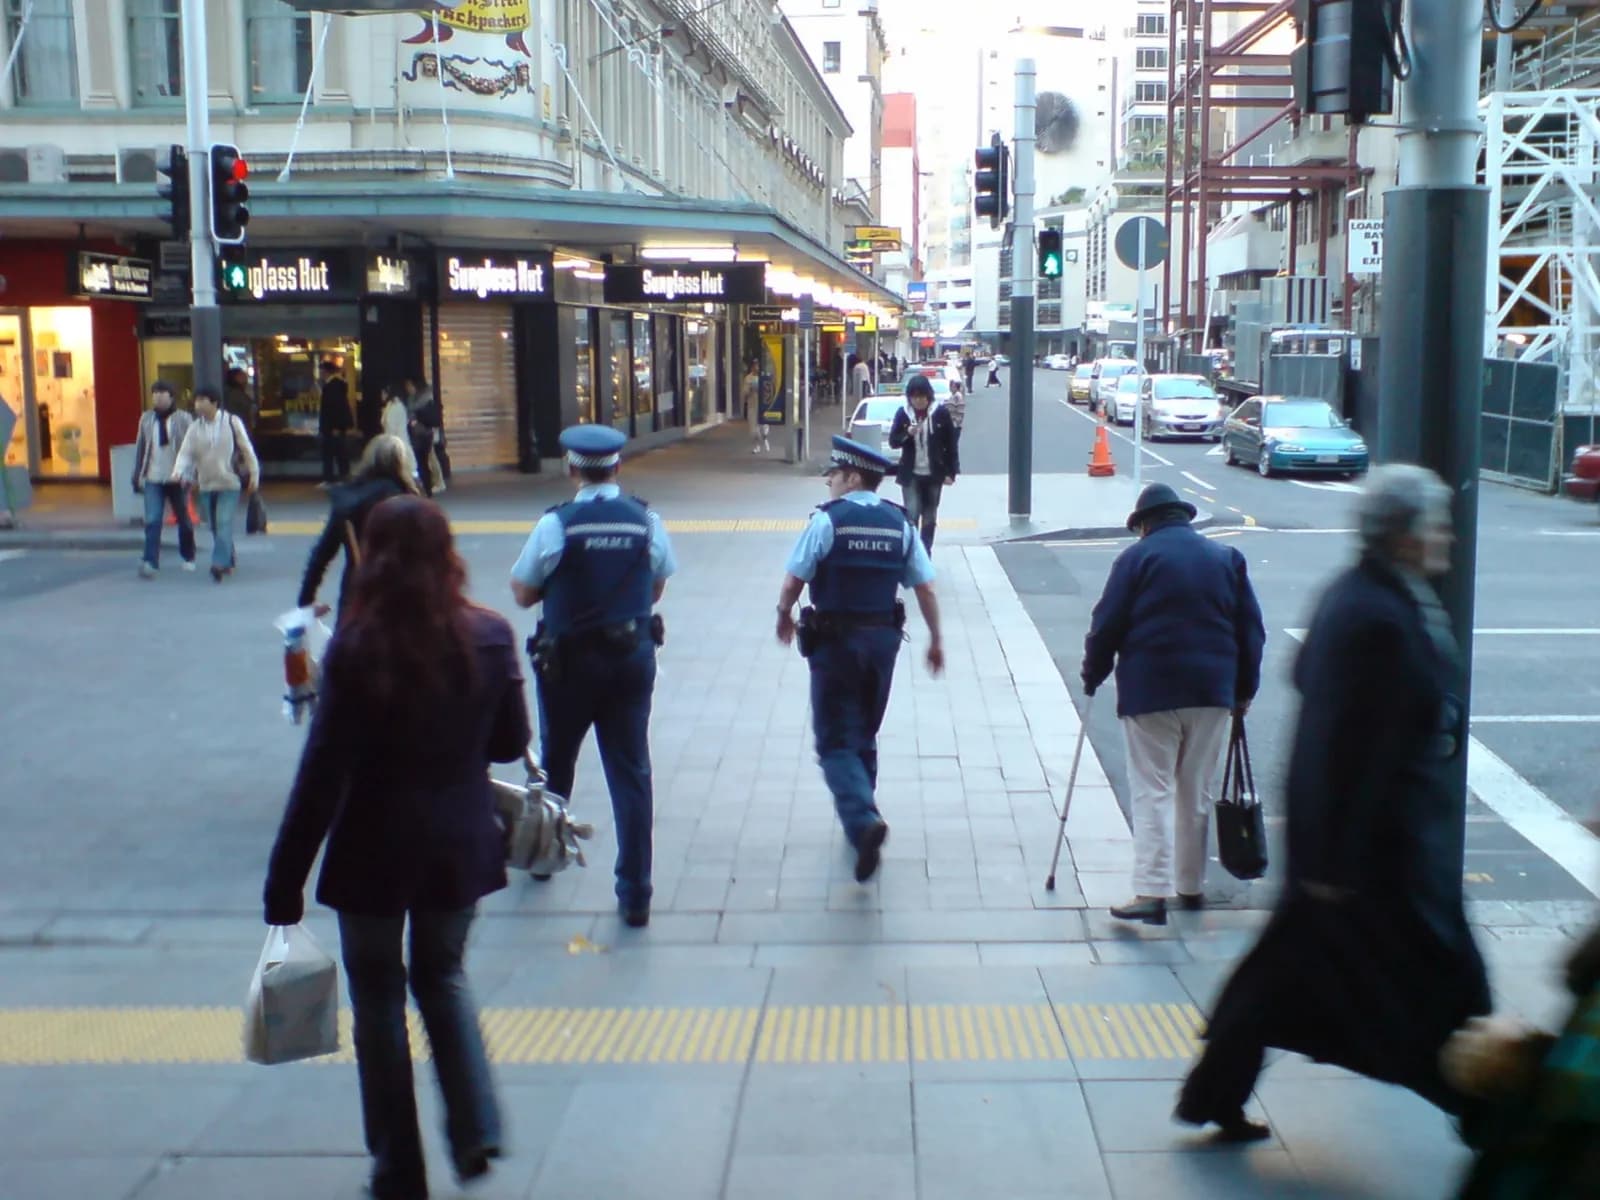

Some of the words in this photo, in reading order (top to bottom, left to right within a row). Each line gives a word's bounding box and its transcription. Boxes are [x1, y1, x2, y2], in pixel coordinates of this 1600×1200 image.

[439, 7, 526, 31] ackpackers
[1371, 241, 1378, 255] 1
[222, 258, 297, 299] glass
[299, 256, 329, 291] Hut
[449, 257, 516, 298] Sunglass
[517, 260, 544, 292] Hut
[642, 270, 700, 299] Sunglass
[701, 271, 724, 295] Hut
[848, 539, 894, 552] POLICE
